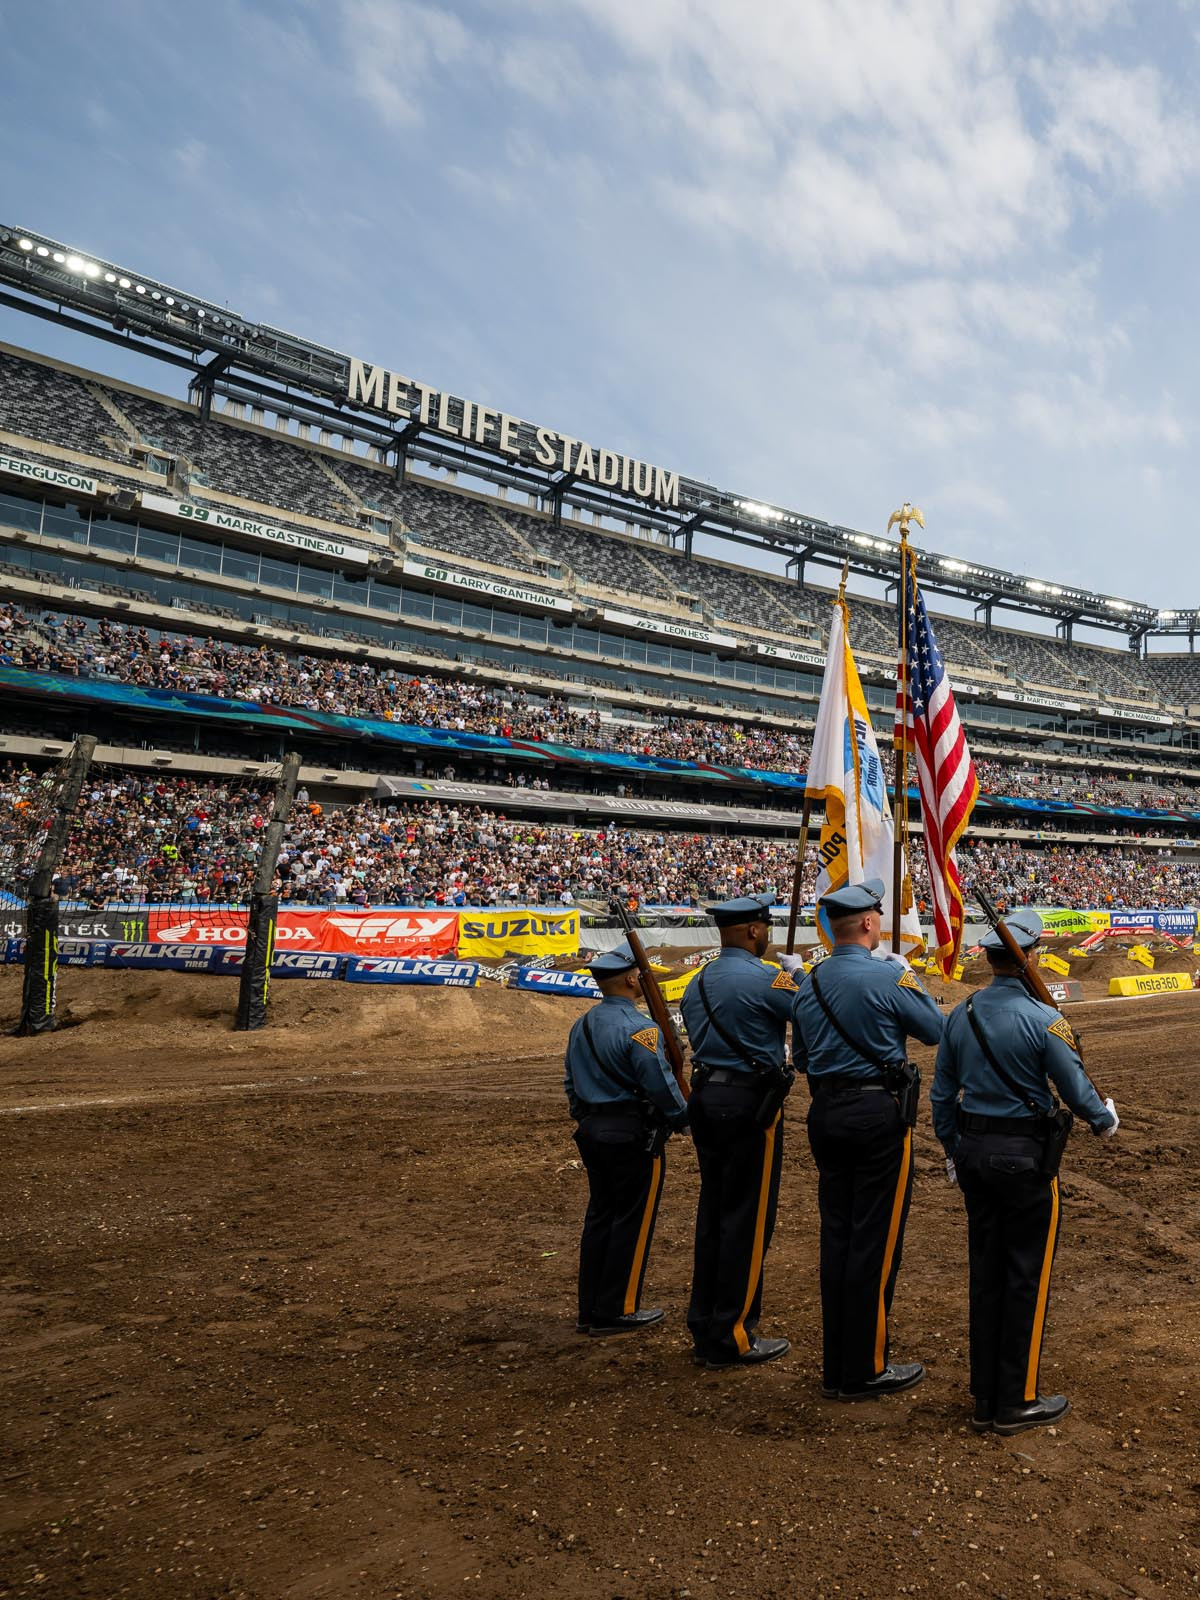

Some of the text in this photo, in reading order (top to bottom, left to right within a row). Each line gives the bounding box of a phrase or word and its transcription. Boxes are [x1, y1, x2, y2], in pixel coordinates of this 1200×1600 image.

[348, 357, 680, 506] METLIFE STADIUM
[178, 503, 346, 557] 99 MARK GASTINEAU
[424, 566, 556, 607] 60 LARRY GRANTHAM
[664, 624, 687, 637] LEON
[688, 628, 711, 641] HESS
[763, 645, 826, 666] 75 WINSTON
[1014, 693, 1025, 702] 93
[1112, 709, 1122, 718] 74
[433, 784, 488, 796] MetLife
[605, 800, 711, 816] METLIFE STADIUM
[326, 917, 456, 938] FLY
[1043, 916, 1086, 929] awasaki
[1112, 915, 1154, 925] FALKEN
[1167, 914, 1196, 926] YAMAHA
[196, 926, 316, 941] HODA
[463, 918, 577, 940] SUZUKI
[355, 936, 432, 945] RACING
[110, 944, 214, 959] FALKEN
[184, 960, 209, 968] TIRES
[355, 958, 475, 978] FALKEN
[306, 969, 333, 978] TIRES
[525, 970, 600, 989] FALKE
[443, 977, 471, 986] TIRES
[1135, 976, 1179, 992] Insta360
